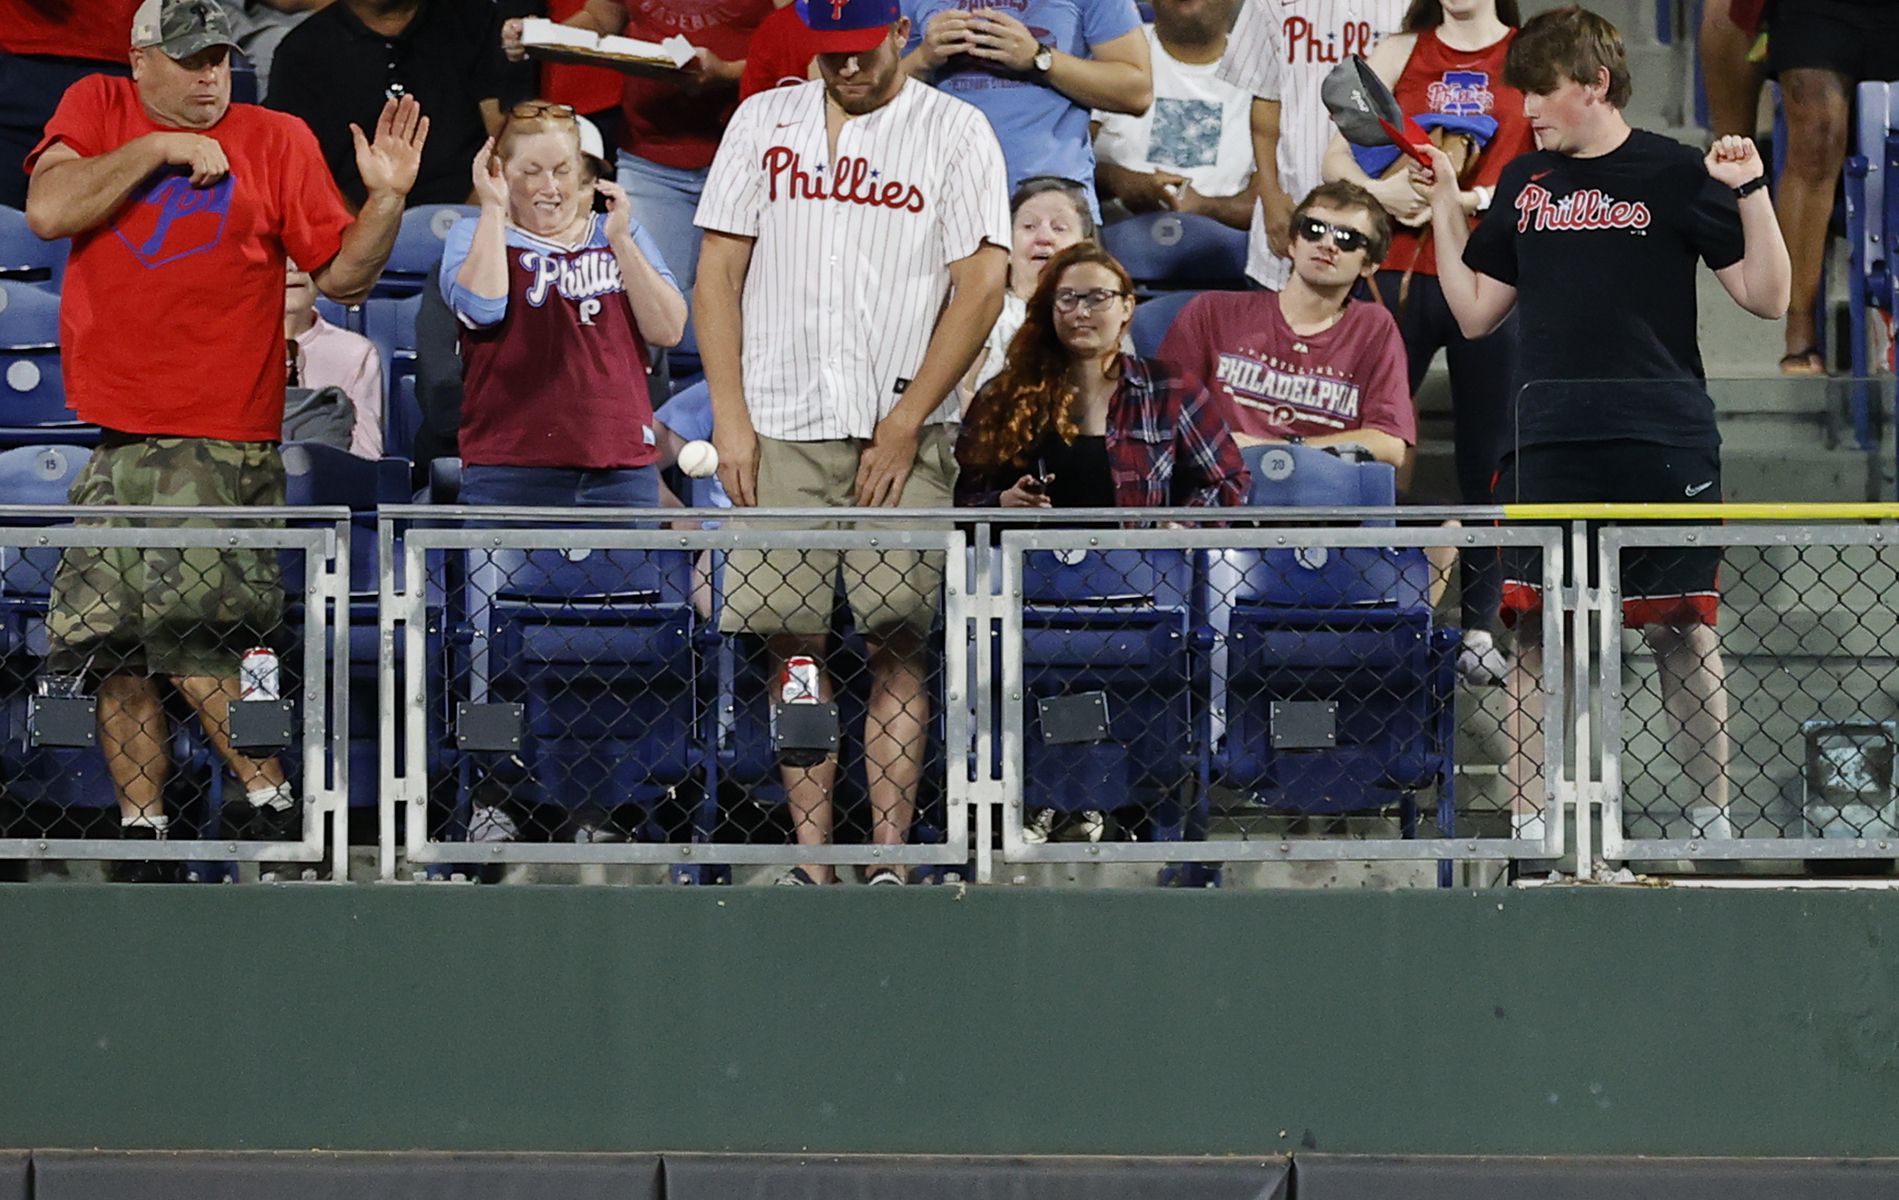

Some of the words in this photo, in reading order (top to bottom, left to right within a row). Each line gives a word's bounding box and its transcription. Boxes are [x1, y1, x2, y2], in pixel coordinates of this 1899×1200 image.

[762, 146, 924, 213] Phillies
[1515, 184, 1651, 233] Phillies
[578, 299, 601, 326] P
[1216, 356, 1359, 418] PHILADELPHIA
